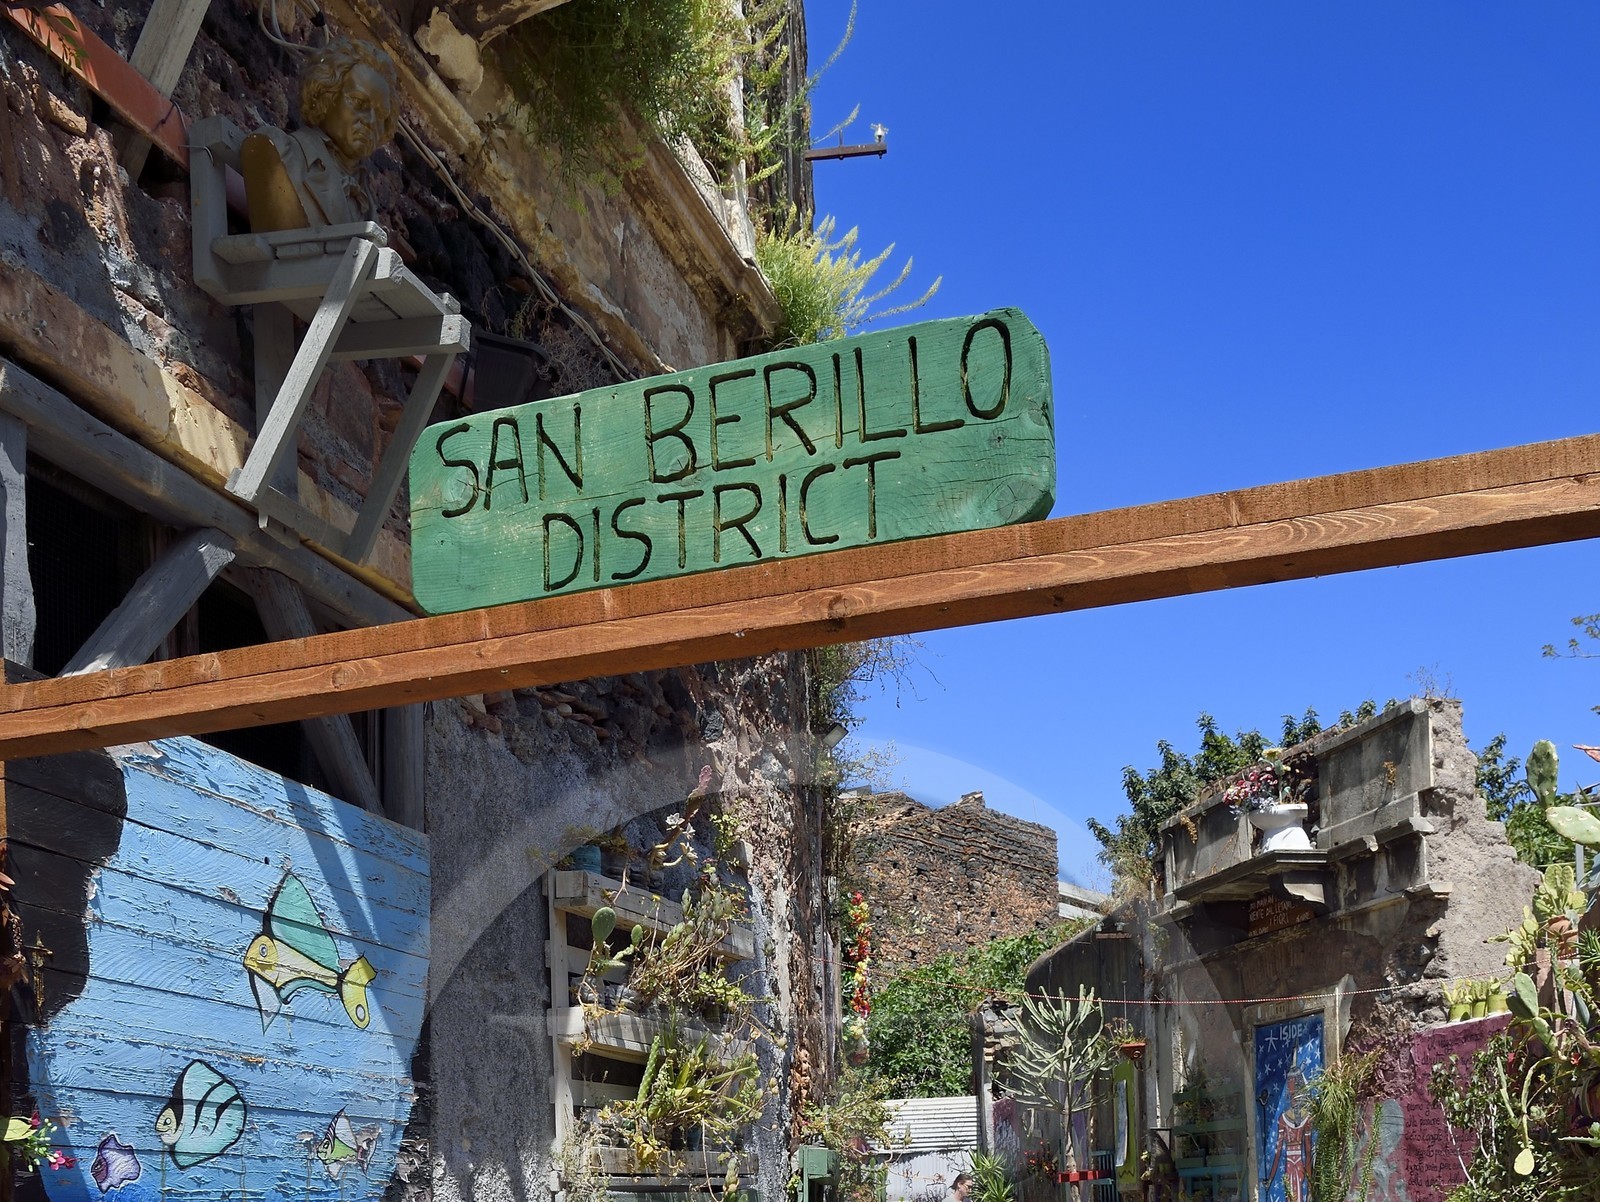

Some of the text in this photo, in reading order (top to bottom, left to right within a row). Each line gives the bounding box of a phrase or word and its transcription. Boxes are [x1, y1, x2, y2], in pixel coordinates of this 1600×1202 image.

[435, 318, 1013, 518] SAN BERILLO
[542, 450, 901, 592] DISTRICT
